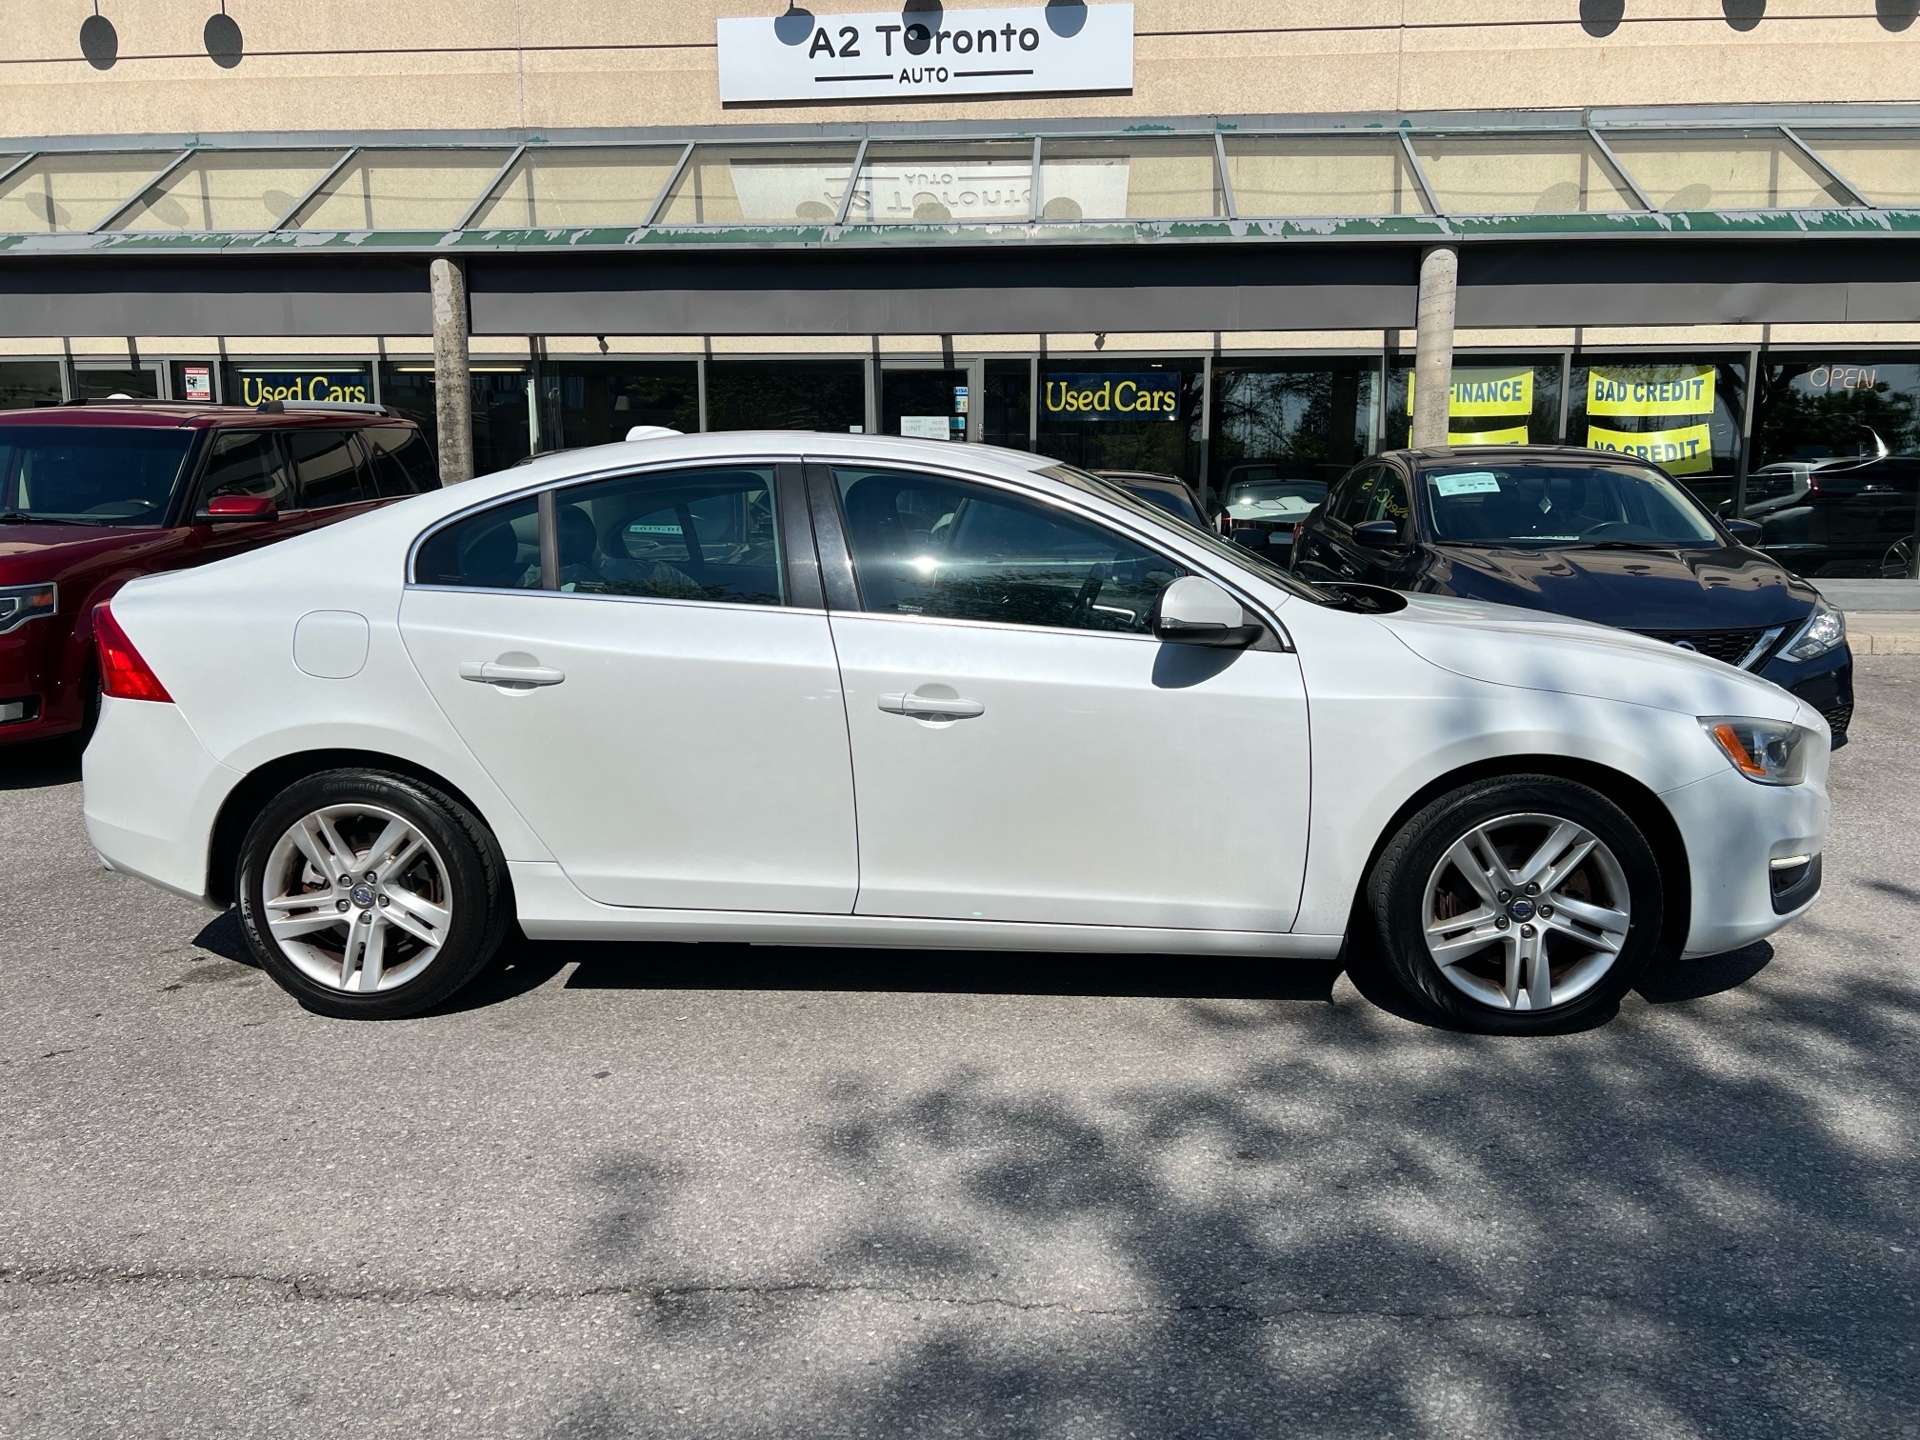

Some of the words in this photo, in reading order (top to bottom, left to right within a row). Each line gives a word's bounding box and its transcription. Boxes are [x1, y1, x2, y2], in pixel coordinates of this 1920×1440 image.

[808, 26, 861, 59] A2
[899, 67, 949, 84] AUTO
[1595, 380, 1628, 402] BAD
[1633, 379, 1705, 402] CREDIT
[1810, 367, 1876, 388] OPEN
[242, 377, 302, 407] Used
[308, 376, 366, 404] Cars
[1046, 380, 1111, 412] Used
[1114, 380, 1176, 412] Cars
